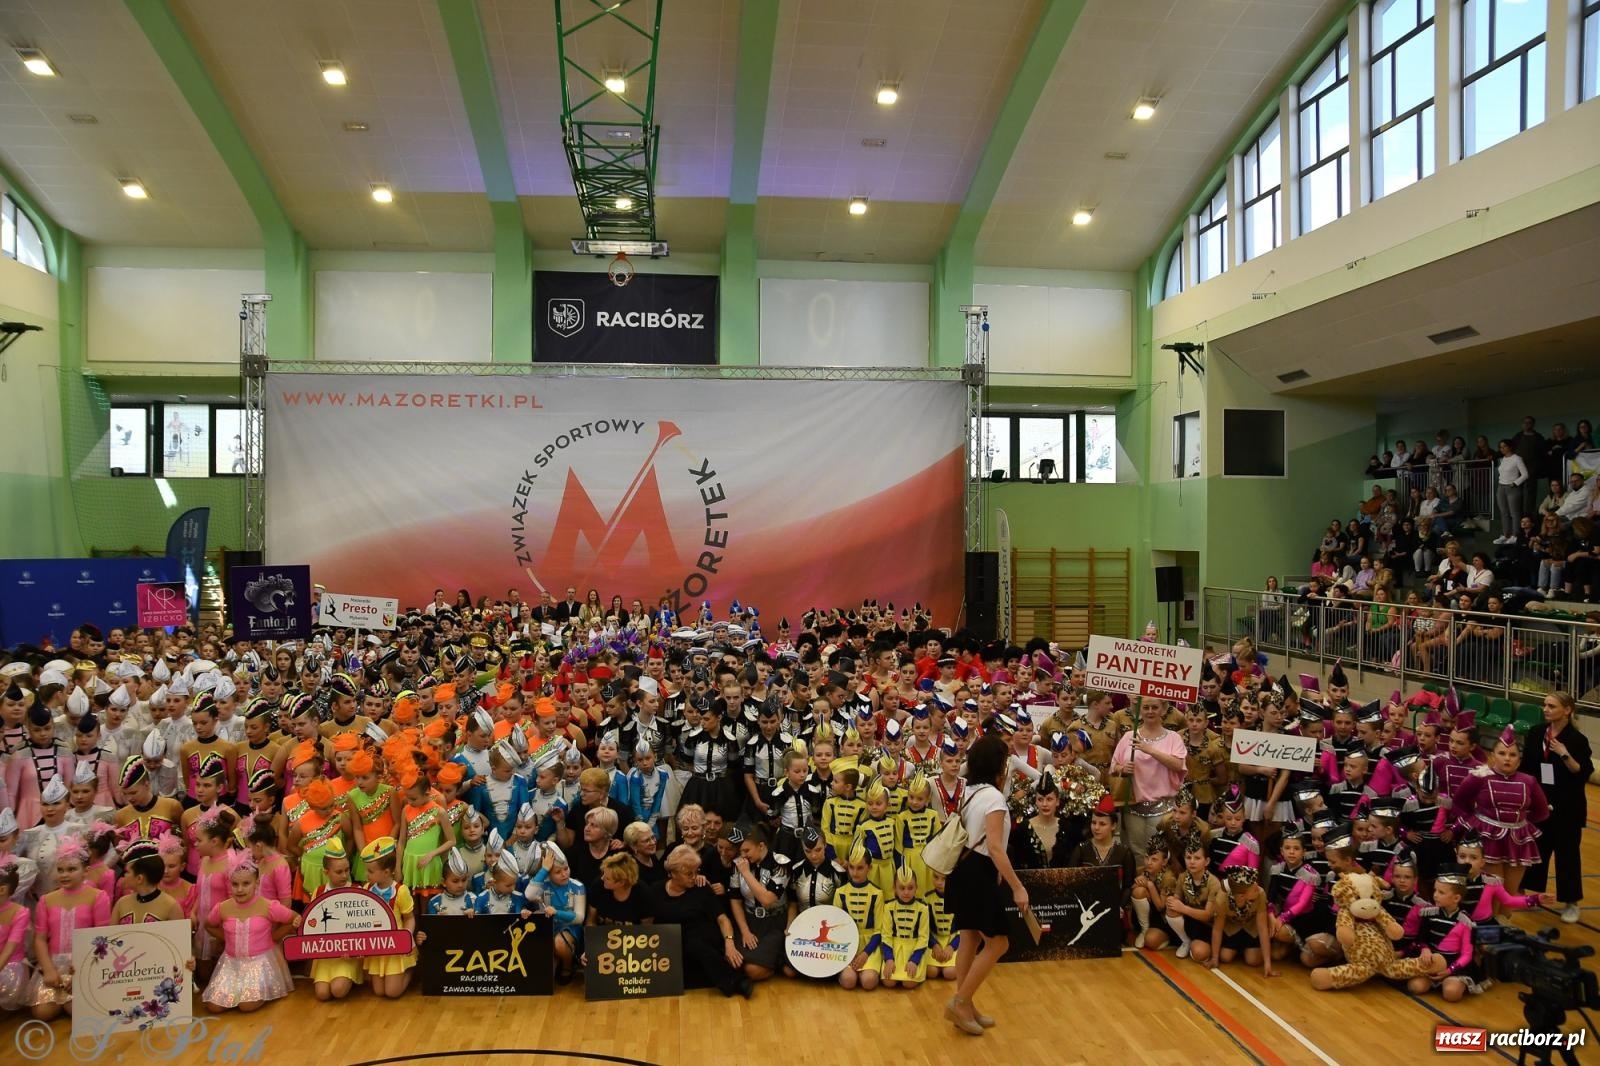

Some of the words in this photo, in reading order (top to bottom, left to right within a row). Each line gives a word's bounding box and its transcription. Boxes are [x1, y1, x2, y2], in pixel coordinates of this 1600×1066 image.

[596, 308, 705, 329] RACIBÓRZ
[282, 391, 544, 410] WWW.MAZORETKI.PL
[511, 469, 538, 567] ZWIĄZEK
[533, 418, 646, 468] SPORTOWY
[650, 457, 729, 625] ŻORETEK
[342, 602, 378, 615] Presto
[143, 614, 183, 623] IZBICKO
[247, 615, 297, 630] Fantazja
[1114, 641, 1177, 659] MAŻORETKI
[1096, 652, 1192, 681] PANTERY
[1091, 675, 1135, 692] Gliwice
[1147, 683, 1191, 700] Poland
[334, 899, 369, 909] STRZELCE
[346, 908, 377, 918] WIELKIE
[345, 921, 372, 930] POLAND
[301, 937, 366, 954] MAŻORETKI
[369, 936, 396, 950] VIVA
[606, 928, 660, 956] Spec
[445, 949, 528, 977] ZARA
[597, 952, 671, 975] Babcie
[790, 949, 848, 962] MARKLOWICE
[101, 960, 166, 981] Fanaberia
[460, 974, 499, 982] RACIBÓRZ
[443, 985, 475, 993] ZAWADA
[618, 976, 651, 985] Racibórz
[622, 986, 647, 995] Polska
